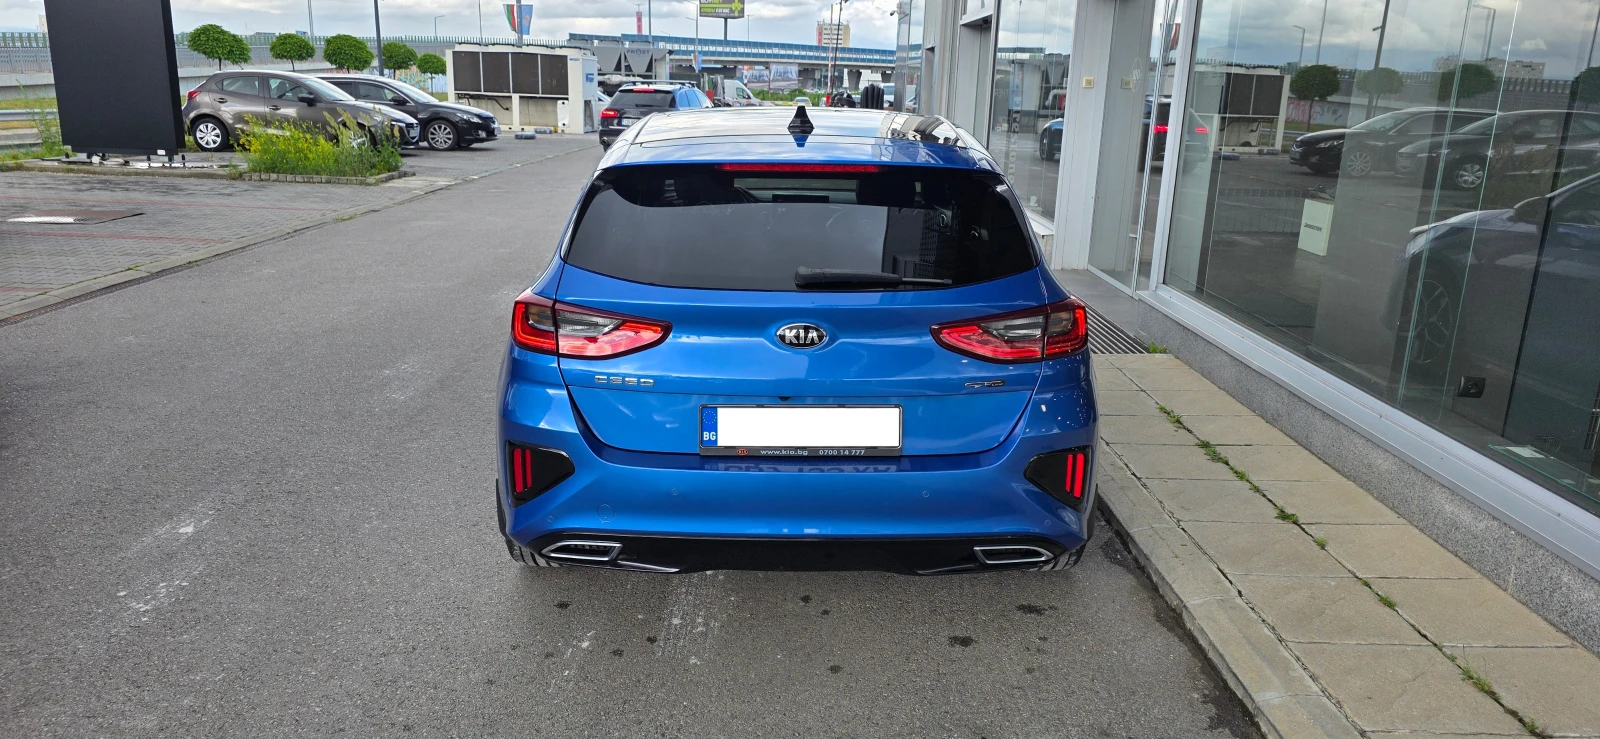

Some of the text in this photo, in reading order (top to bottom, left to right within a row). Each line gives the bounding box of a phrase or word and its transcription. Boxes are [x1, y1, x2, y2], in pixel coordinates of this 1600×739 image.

[784, 329, 820, 344] KIA
[594, 375, 654, 387] CEED
[703, 432, 716, 441] BG
